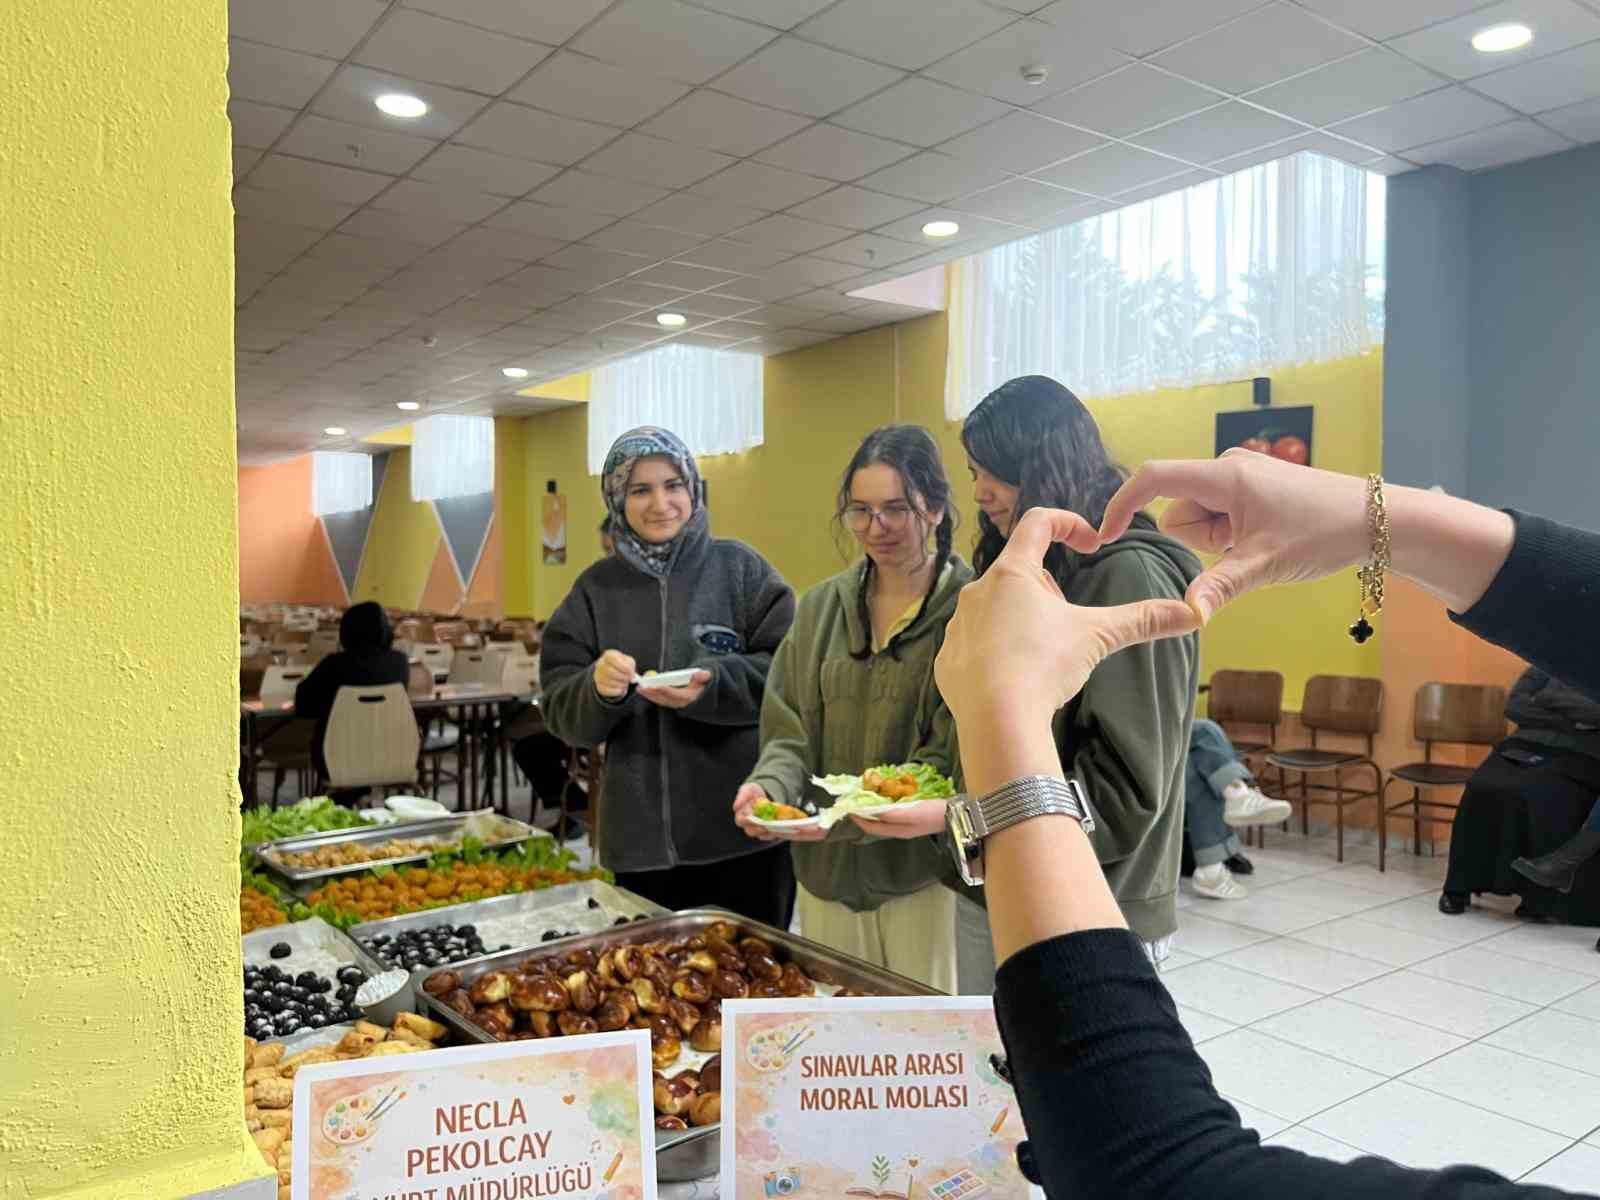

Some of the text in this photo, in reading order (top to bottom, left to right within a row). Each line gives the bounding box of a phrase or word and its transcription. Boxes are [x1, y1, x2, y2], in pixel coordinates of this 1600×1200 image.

[800, 1052, 964, 1079] SINAVLAR ARASI
[800, 1084, 968, 1111] MORAL MOLASI
[436, 1097, 527, 1136] NECLA
[407, 1130, 553, 1178] PEKOLCAY
